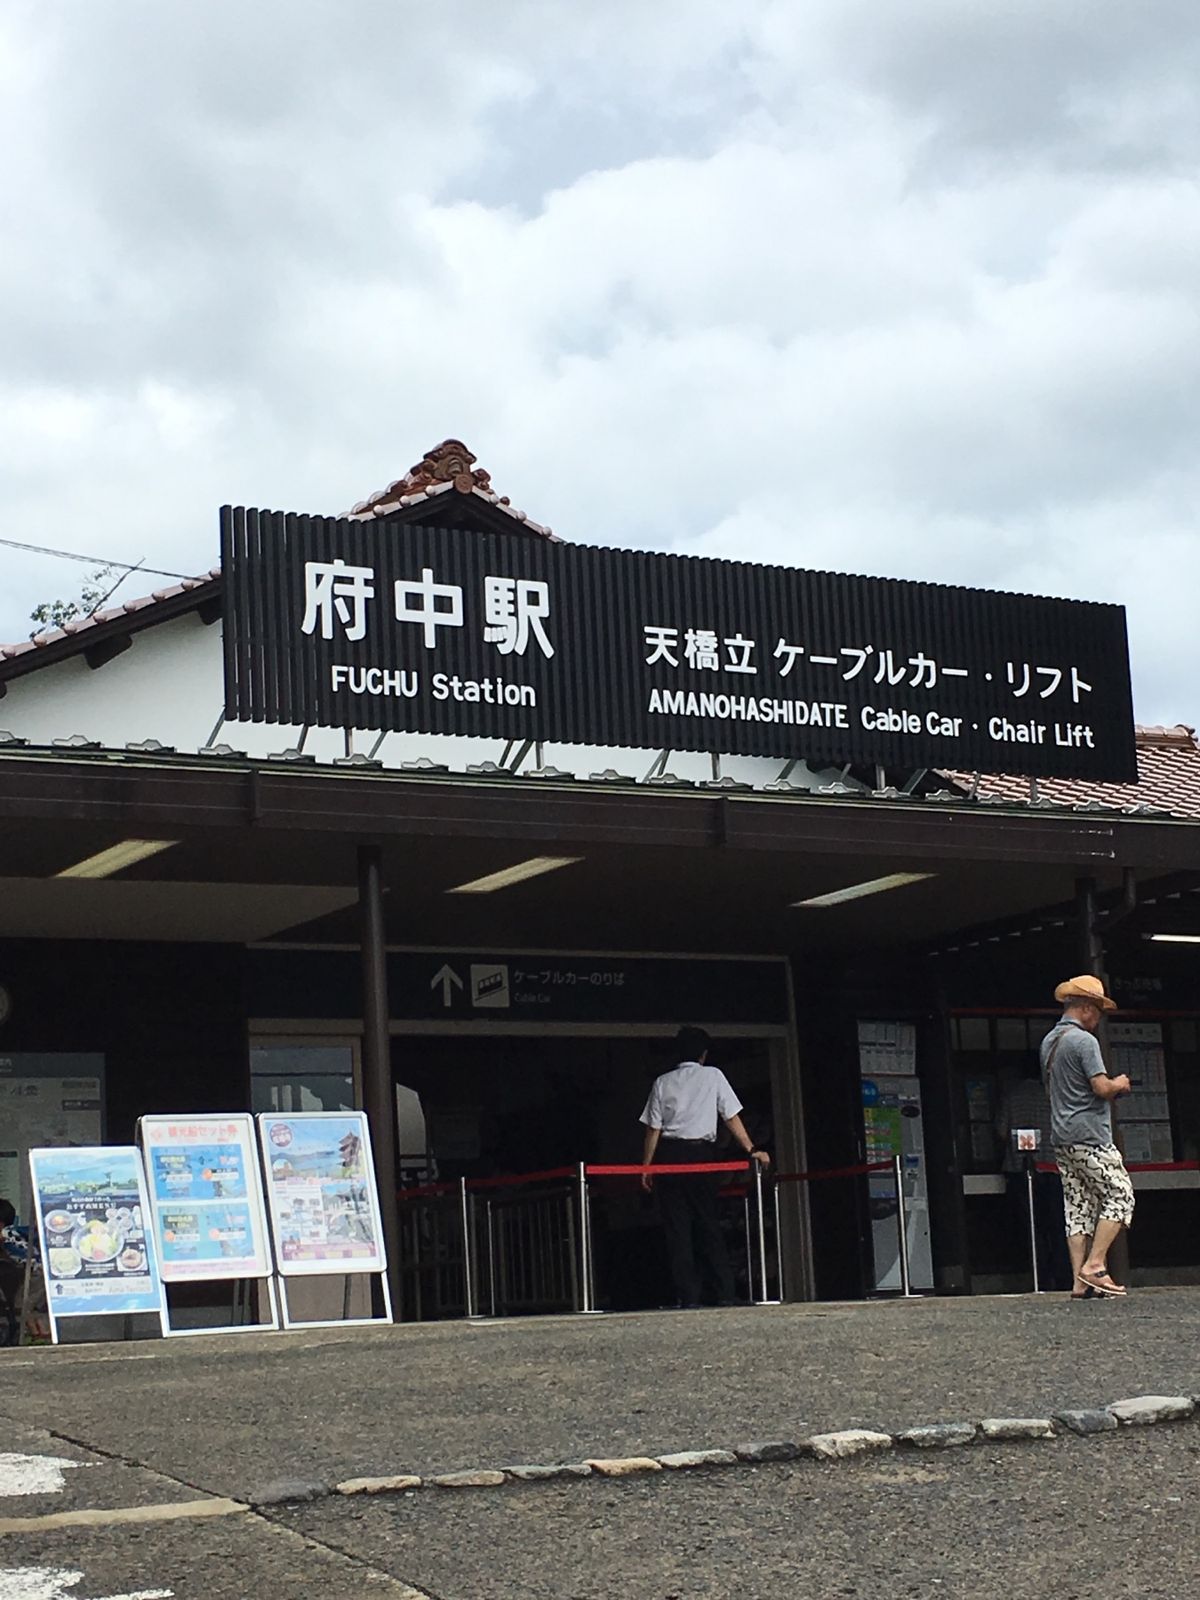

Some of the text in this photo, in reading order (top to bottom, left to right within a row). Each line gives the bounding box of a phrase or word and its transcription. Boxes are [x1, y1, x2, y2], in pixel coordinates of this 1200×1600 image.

[300, 558, 555, 659] 府中駅
[643, 625, 758, 674] 天橋立
[331, 665, 536, 707] FUCHU Station
[648, 688, 850, 729] AMANOHASHIDATE
[861, 705, 922, 734] Cable
[925, 711, 963, 737] Car
[988, 716, 1047, 744] Chair
[1054, 722, 1095, 748] Lift
